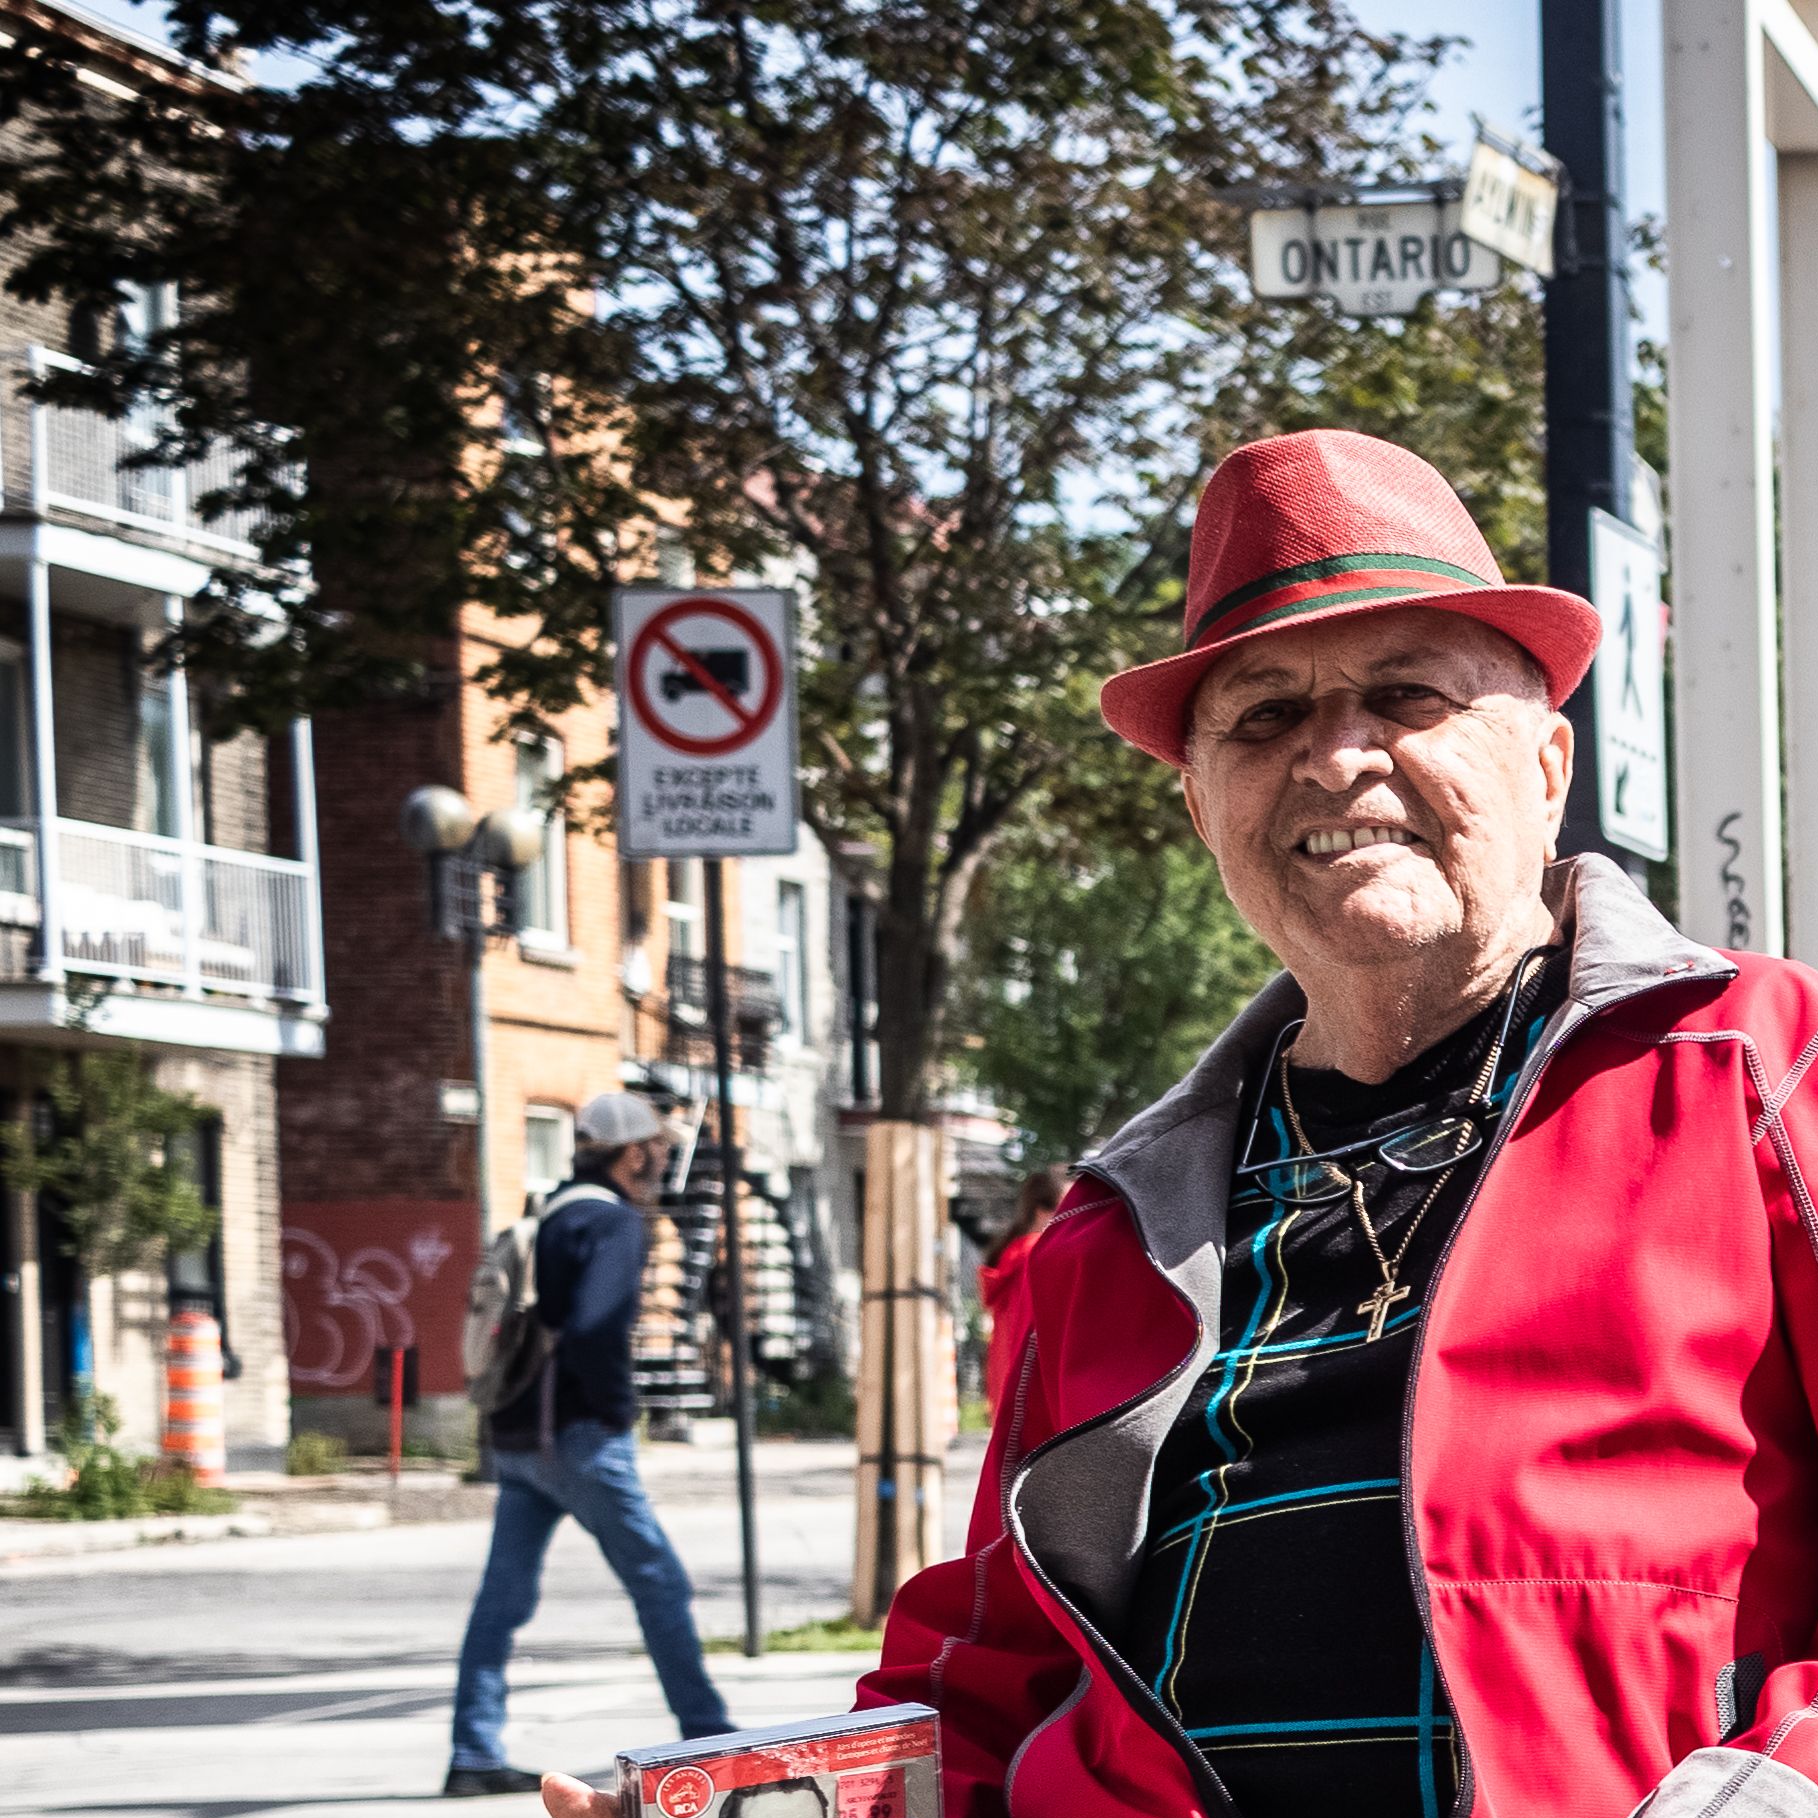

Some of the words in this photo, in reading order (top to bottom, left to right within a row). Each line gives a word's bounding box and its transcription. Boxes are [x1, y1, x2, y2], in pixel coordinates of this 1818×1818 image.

[1281, 231, 1471, 284] ONTARIO
[641, 791, 776, 817] LIVRAISON
[663, 817, 752, 837] LOCALE
[674, 1801, 699, 1815] RCA
